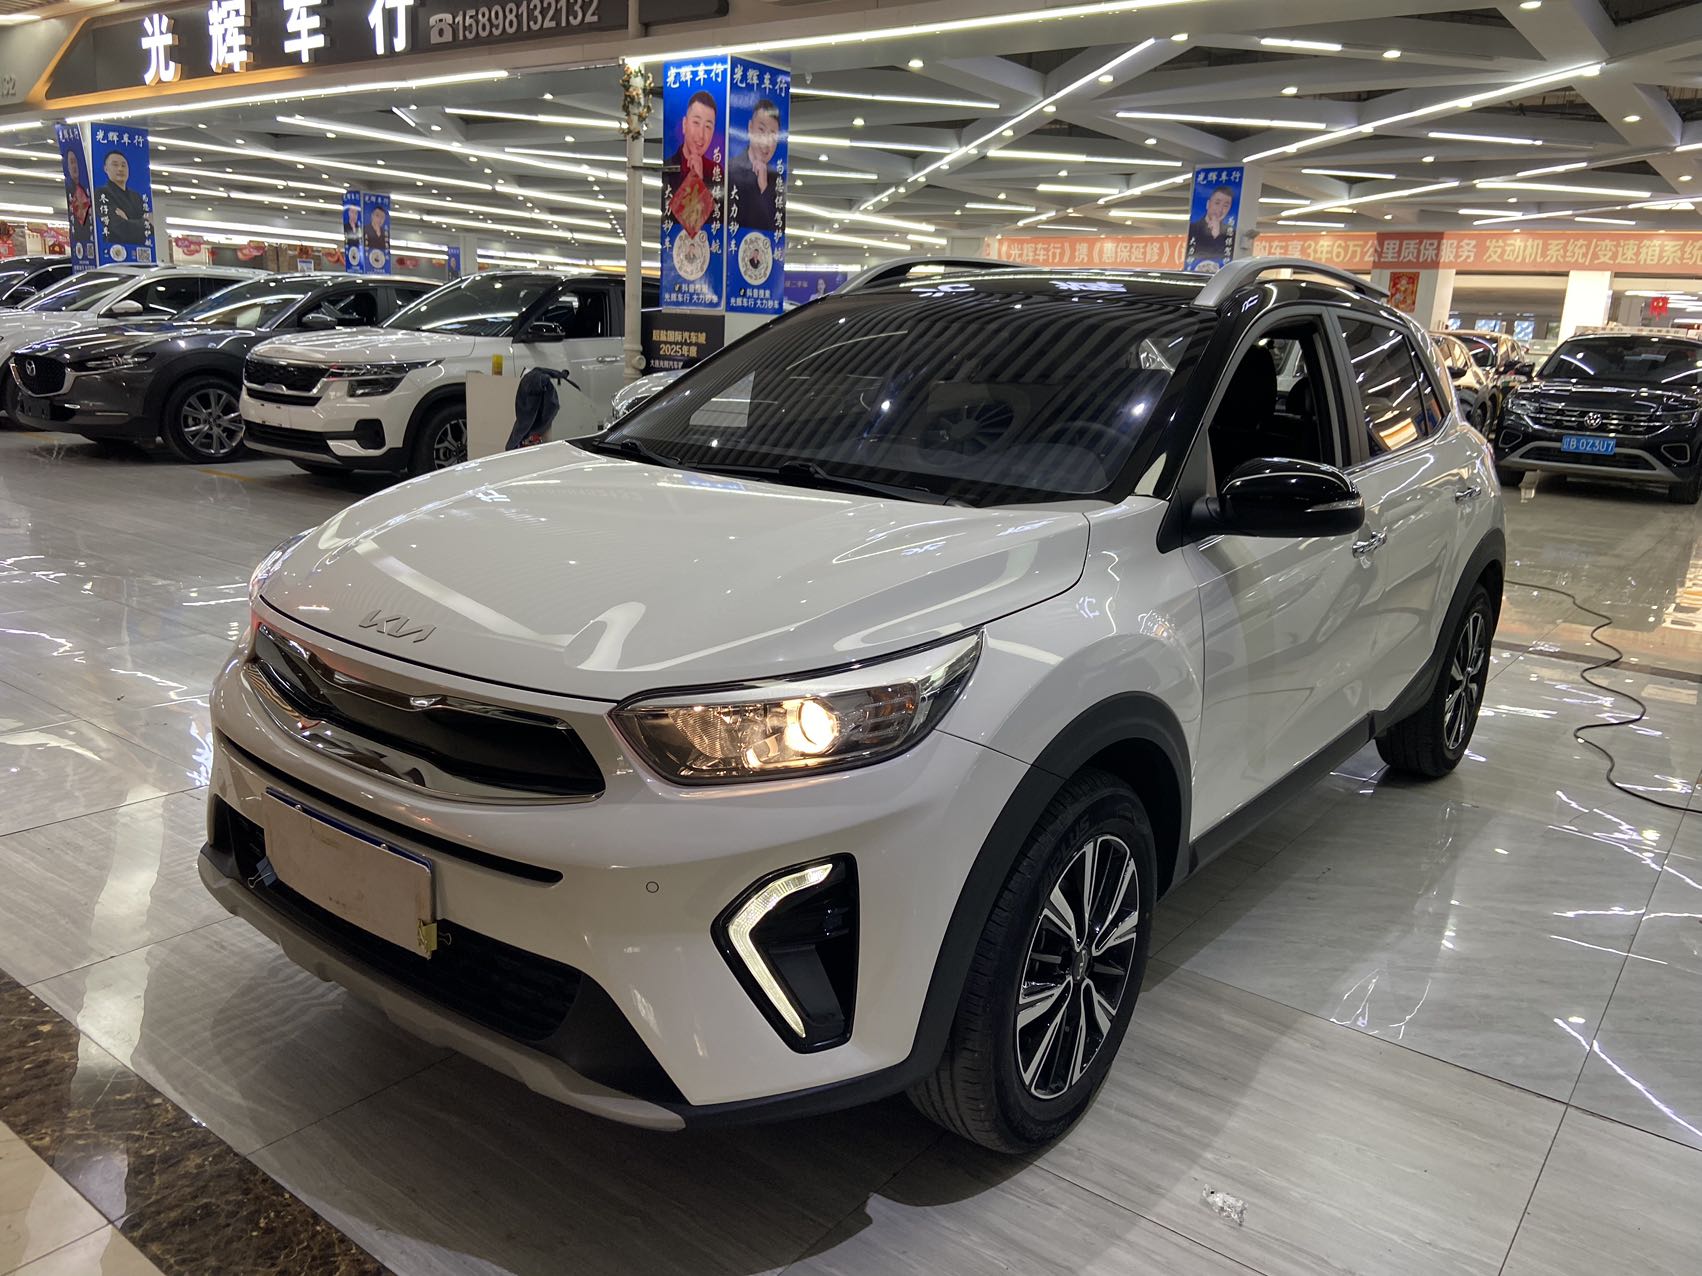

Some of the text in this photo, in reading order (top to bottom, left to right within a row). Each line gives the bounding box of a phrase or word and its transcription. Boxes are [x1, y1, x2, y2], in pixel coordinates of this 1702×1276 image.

[455, 0, 599, 41] 15898132132
[141, 0, 414, 86] 光辉车行
[667, 61, 726, 89] 光辉车行
[733, 64, 788, 97] 光辉车行
[96, 129, 145, 147] 光辉车行
[1483, 238, 1702, 266] 发动机系统/变速箱系统
[659, 343, 698, 358] 2025年度
